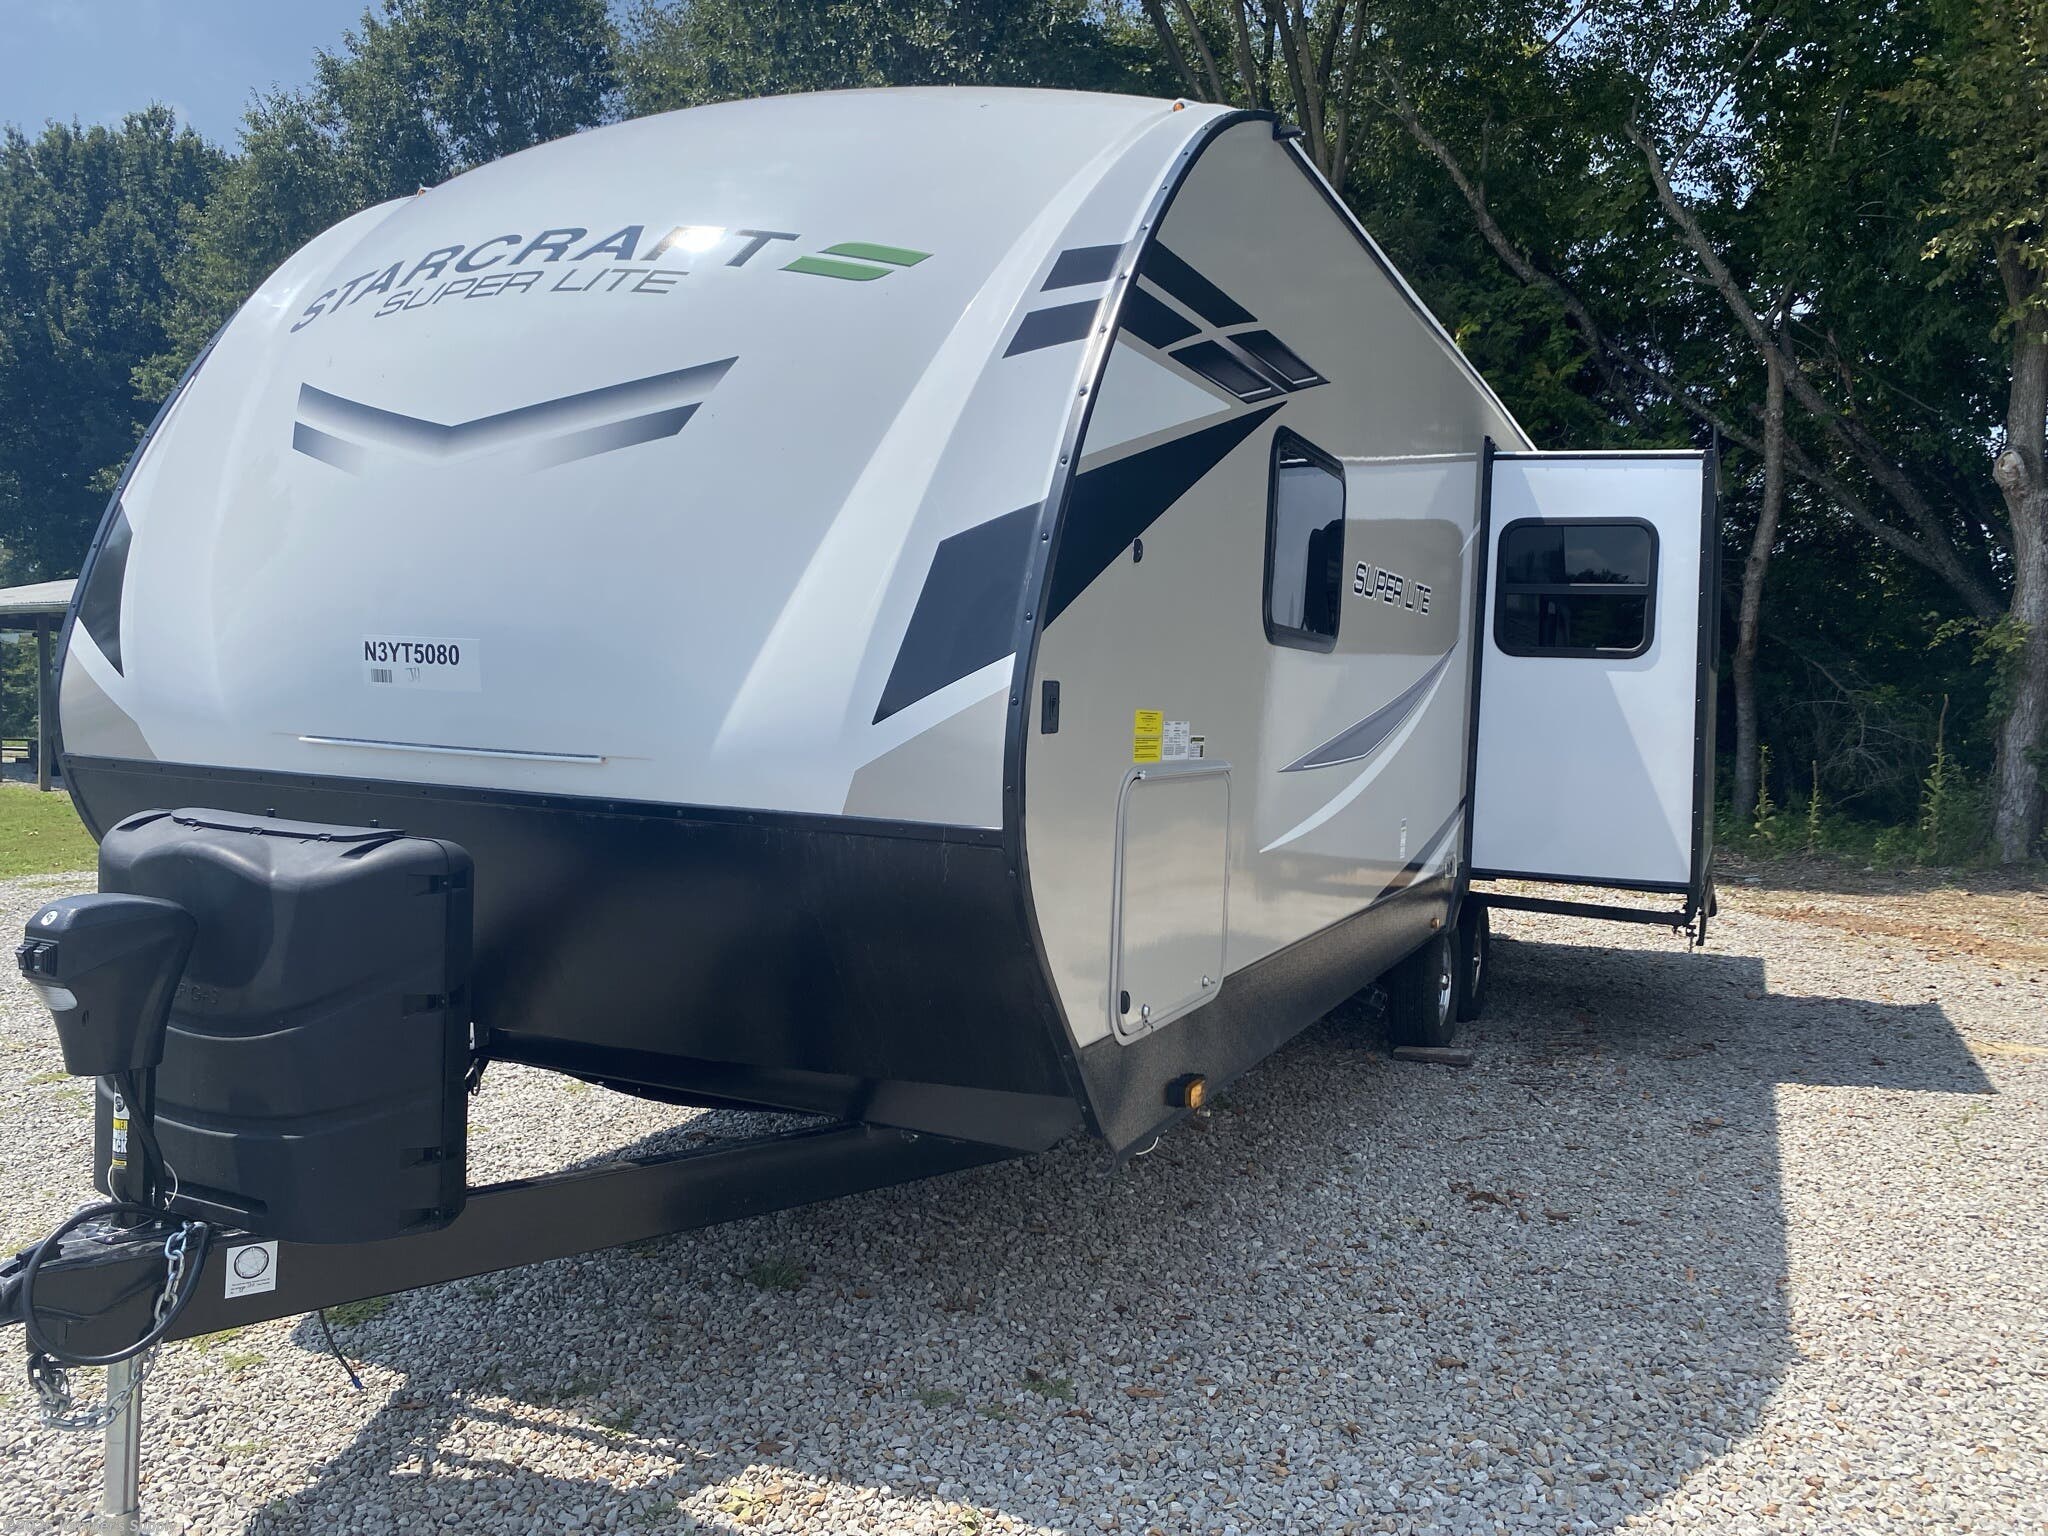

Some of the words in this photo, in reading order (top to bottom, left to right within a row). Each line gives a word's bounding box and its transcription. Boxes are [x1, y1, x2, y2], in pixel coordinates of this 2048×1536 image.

[290, 224, 800, 332] STARCRAFT
[374, 269, 542, 318] SUPER
[552, 267, 690, 295] LITE
[1353, 560, 1404, 608] SUPER
[1404, 579, 1432, 616] LITE
[364, 641, 460, 666] N3YT5080
